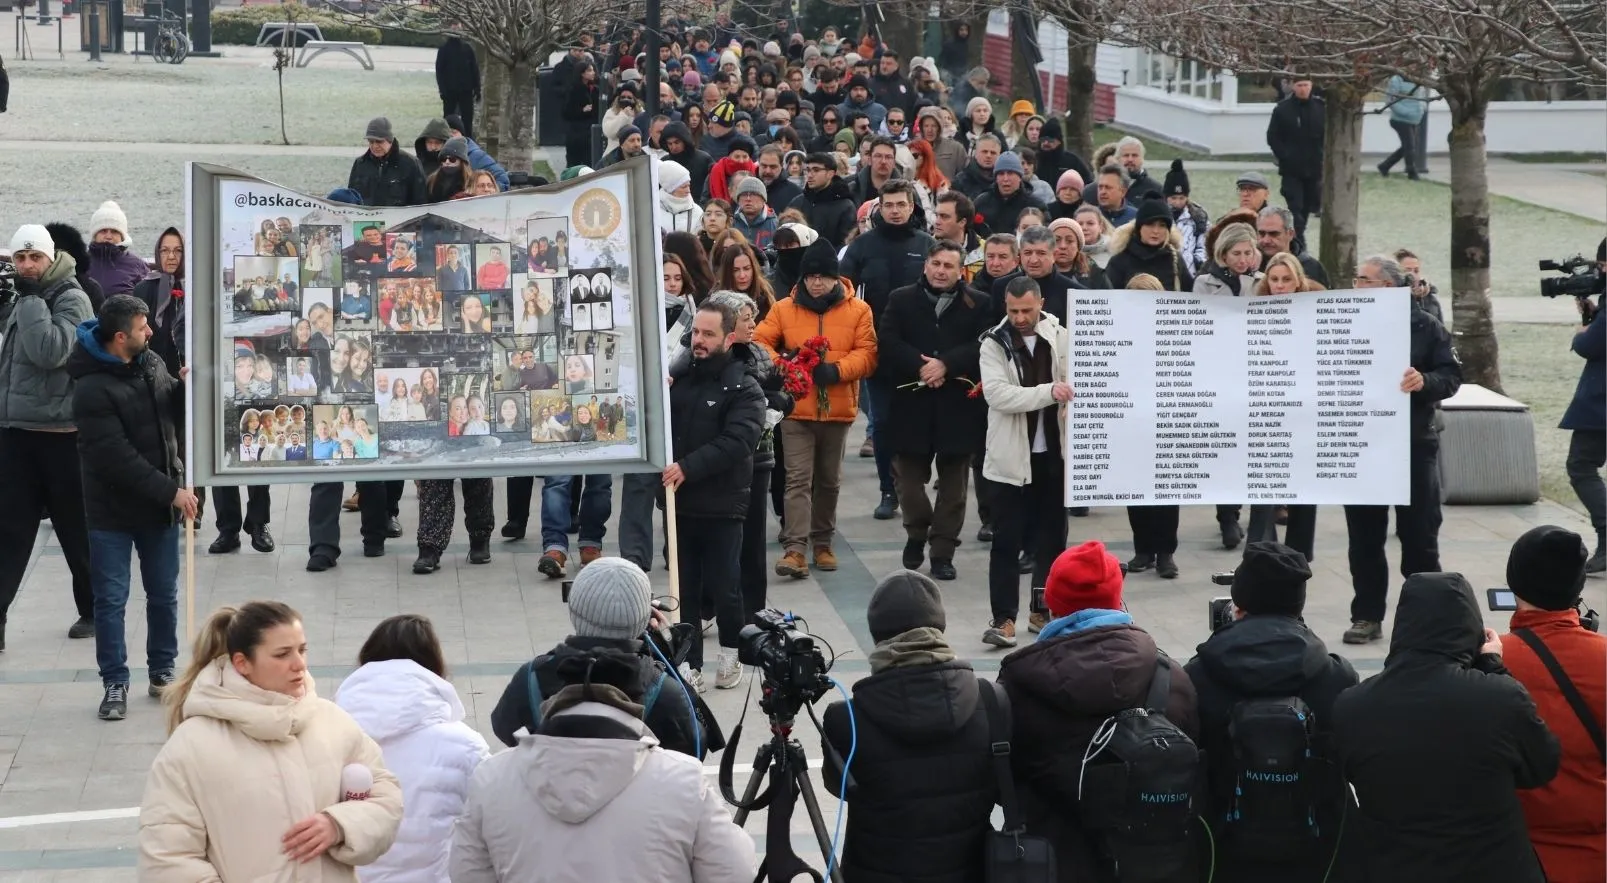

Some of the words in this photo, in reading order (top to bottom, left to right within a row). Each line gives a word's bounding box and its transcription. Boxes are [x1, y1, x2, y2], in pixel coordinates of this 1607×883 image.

[1094, 308, 1112, 316] AKİŞLİ
[1075, 319, 1095, 327] GÜLÇİN
[1096, 319, 1114, 327] AKİŞLİ
[1156, 318, 1180, 326] AYŞEMİN
[1092, 432, 1108, 440] ÇETİZ
[1092, 442, 1107, 450] ÇETİZ
[1095, 453, 1110, 461] ÇETİZ
[1094, 463, 1109, 471] ÇETİZ
[1246, 769, 1299, 782] HAIVISION
